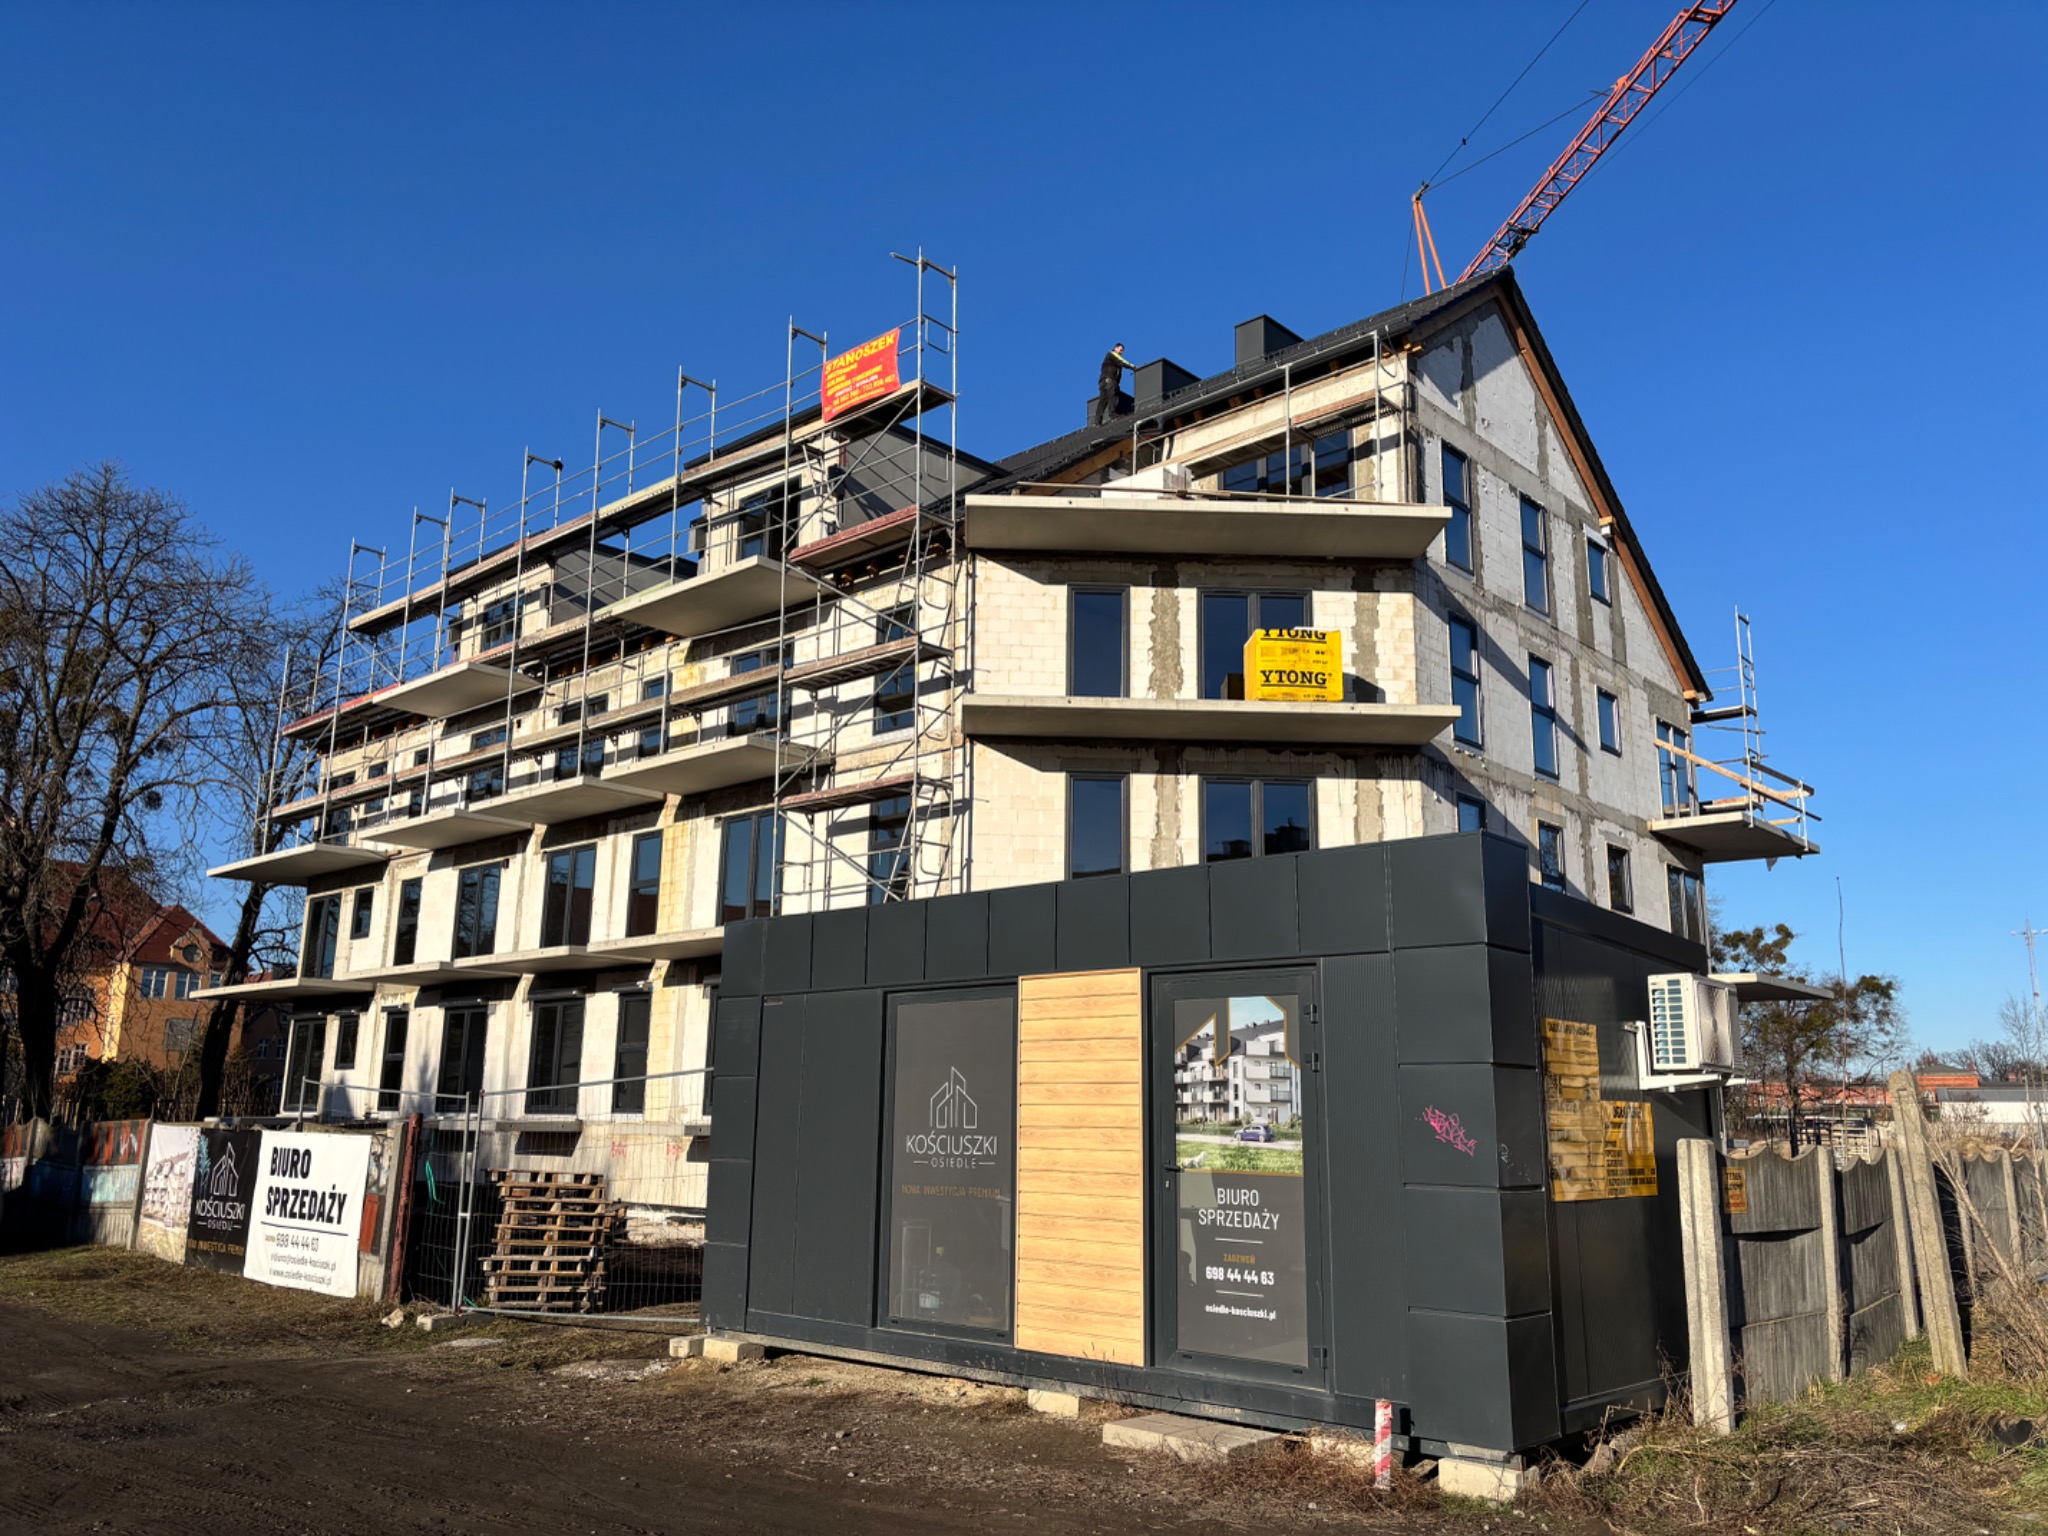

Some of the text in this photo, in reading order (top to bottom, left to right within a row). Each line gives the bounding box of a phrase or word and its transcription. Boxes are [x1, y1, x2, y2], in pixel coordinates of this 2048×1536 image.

[825, 333, 896, 375] STANOSZEK
[1260, 670, 1327, 685] YTONG
[905, 1130, 998, 1155] KOŚCIUSZKI
[270, 1146, 312, 1179] BIURO
[931, 1157, 976, 1169] OSIEDLE
[901, 1184, 920, 1196] NOWA
[968, 1187, 1001, 1199] PREMIUM
[1217, 1188, 1259, 1206] BIURO
[195, 1197, 245, 1220] KOŚCIUSZKI
[266, 1184, 347, 1225] SPRZEDAŻY
[1198, 1208, 1280, 1231] SPRZEDAŻY
[1205, 1266, 1274, 1285] 698 44 44 63
[1205, 1304, 1277, 1321] osiedle-kosciuszki.pl
